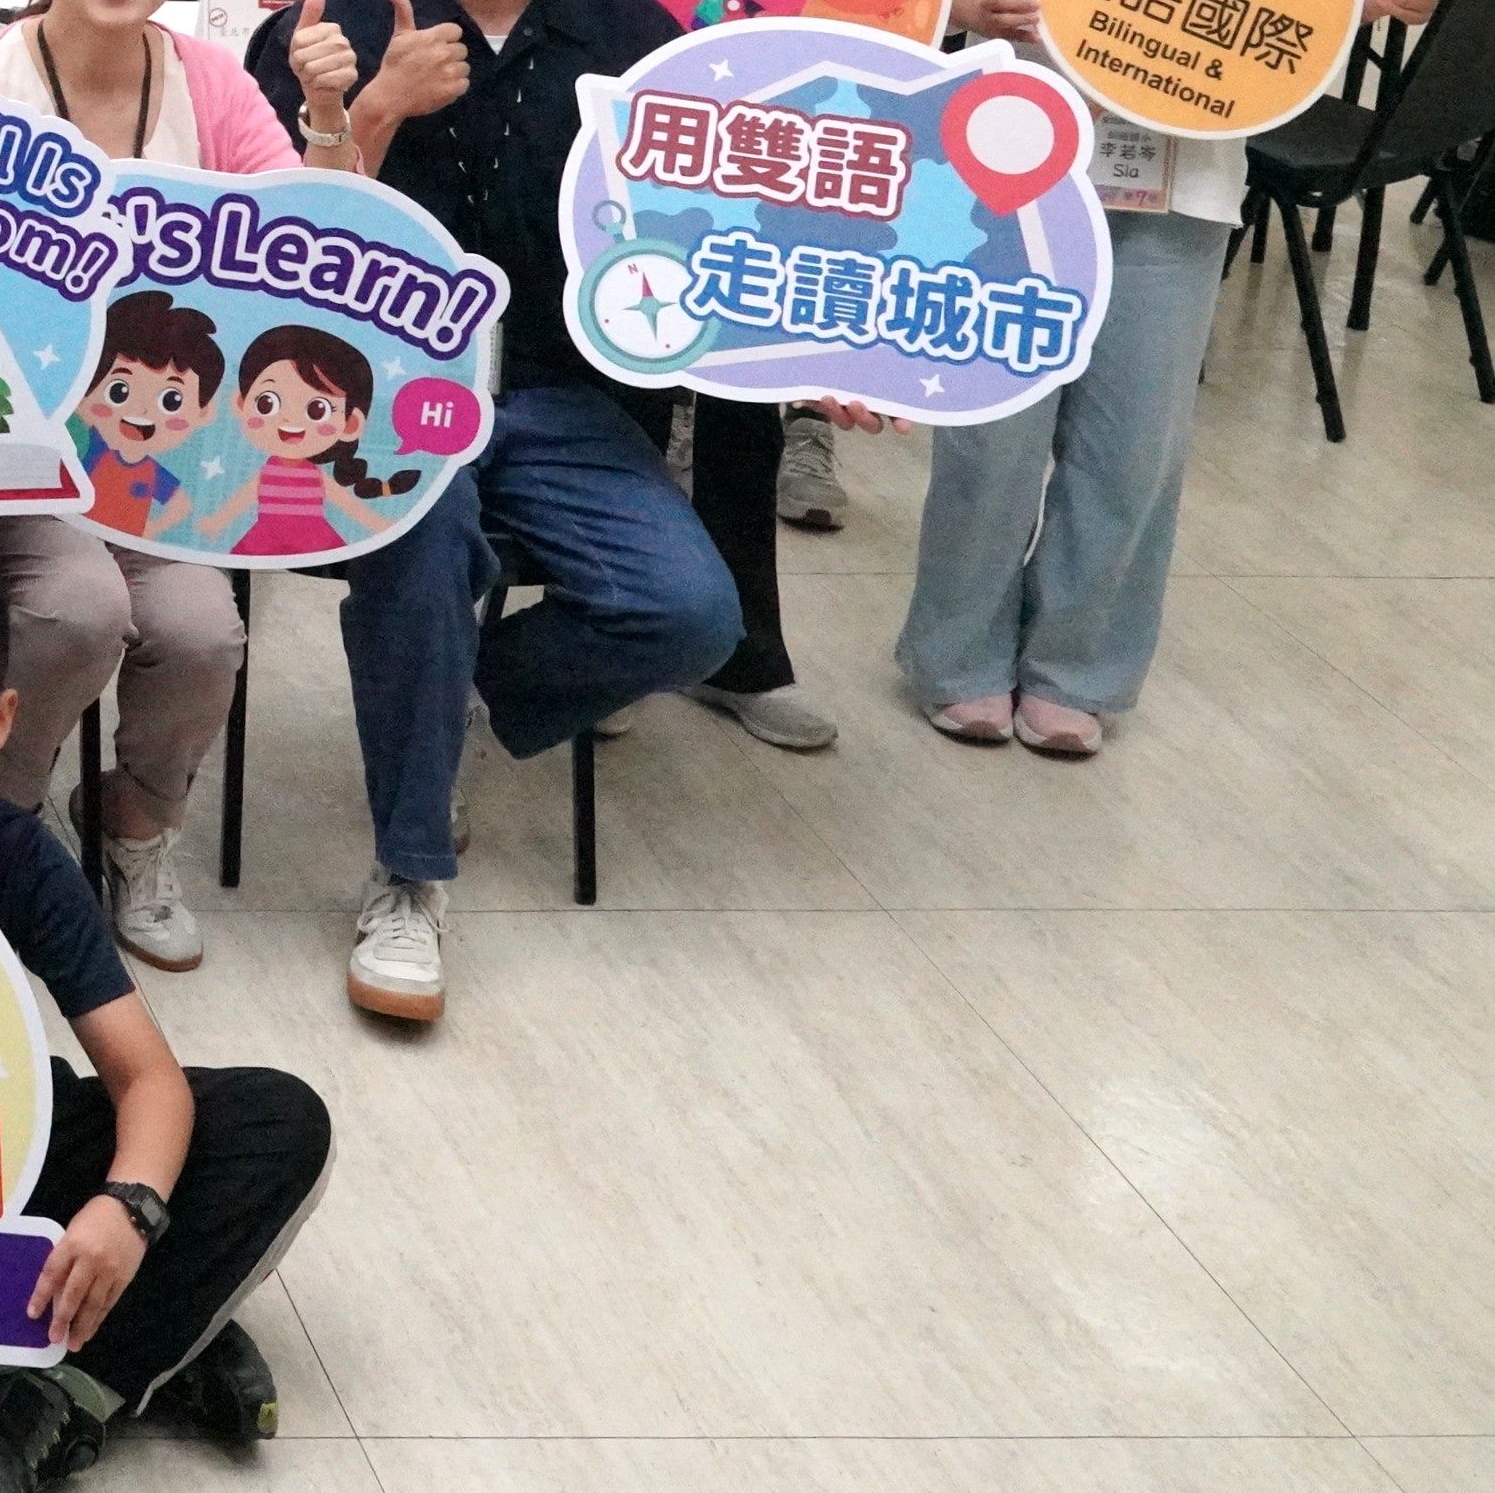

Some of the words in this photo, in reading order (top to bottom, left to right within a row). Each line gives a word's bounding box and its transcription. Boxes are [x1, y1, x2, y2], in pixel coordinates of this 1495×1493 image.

[1076, 38, 1235, 120] International
[1088, 9, 1202, 71] Bilingual
[1204, 59, 1224, 81] &
[27, 136, 93, 209] Is
[623, 94, 906, 216] 用雙語
[213, 201, 489, 352] Learn!
[627, 263, 640, 276] N
[687, 233, 1081, 372] 走讀城市
[420, 400, 454, 429] Hi
